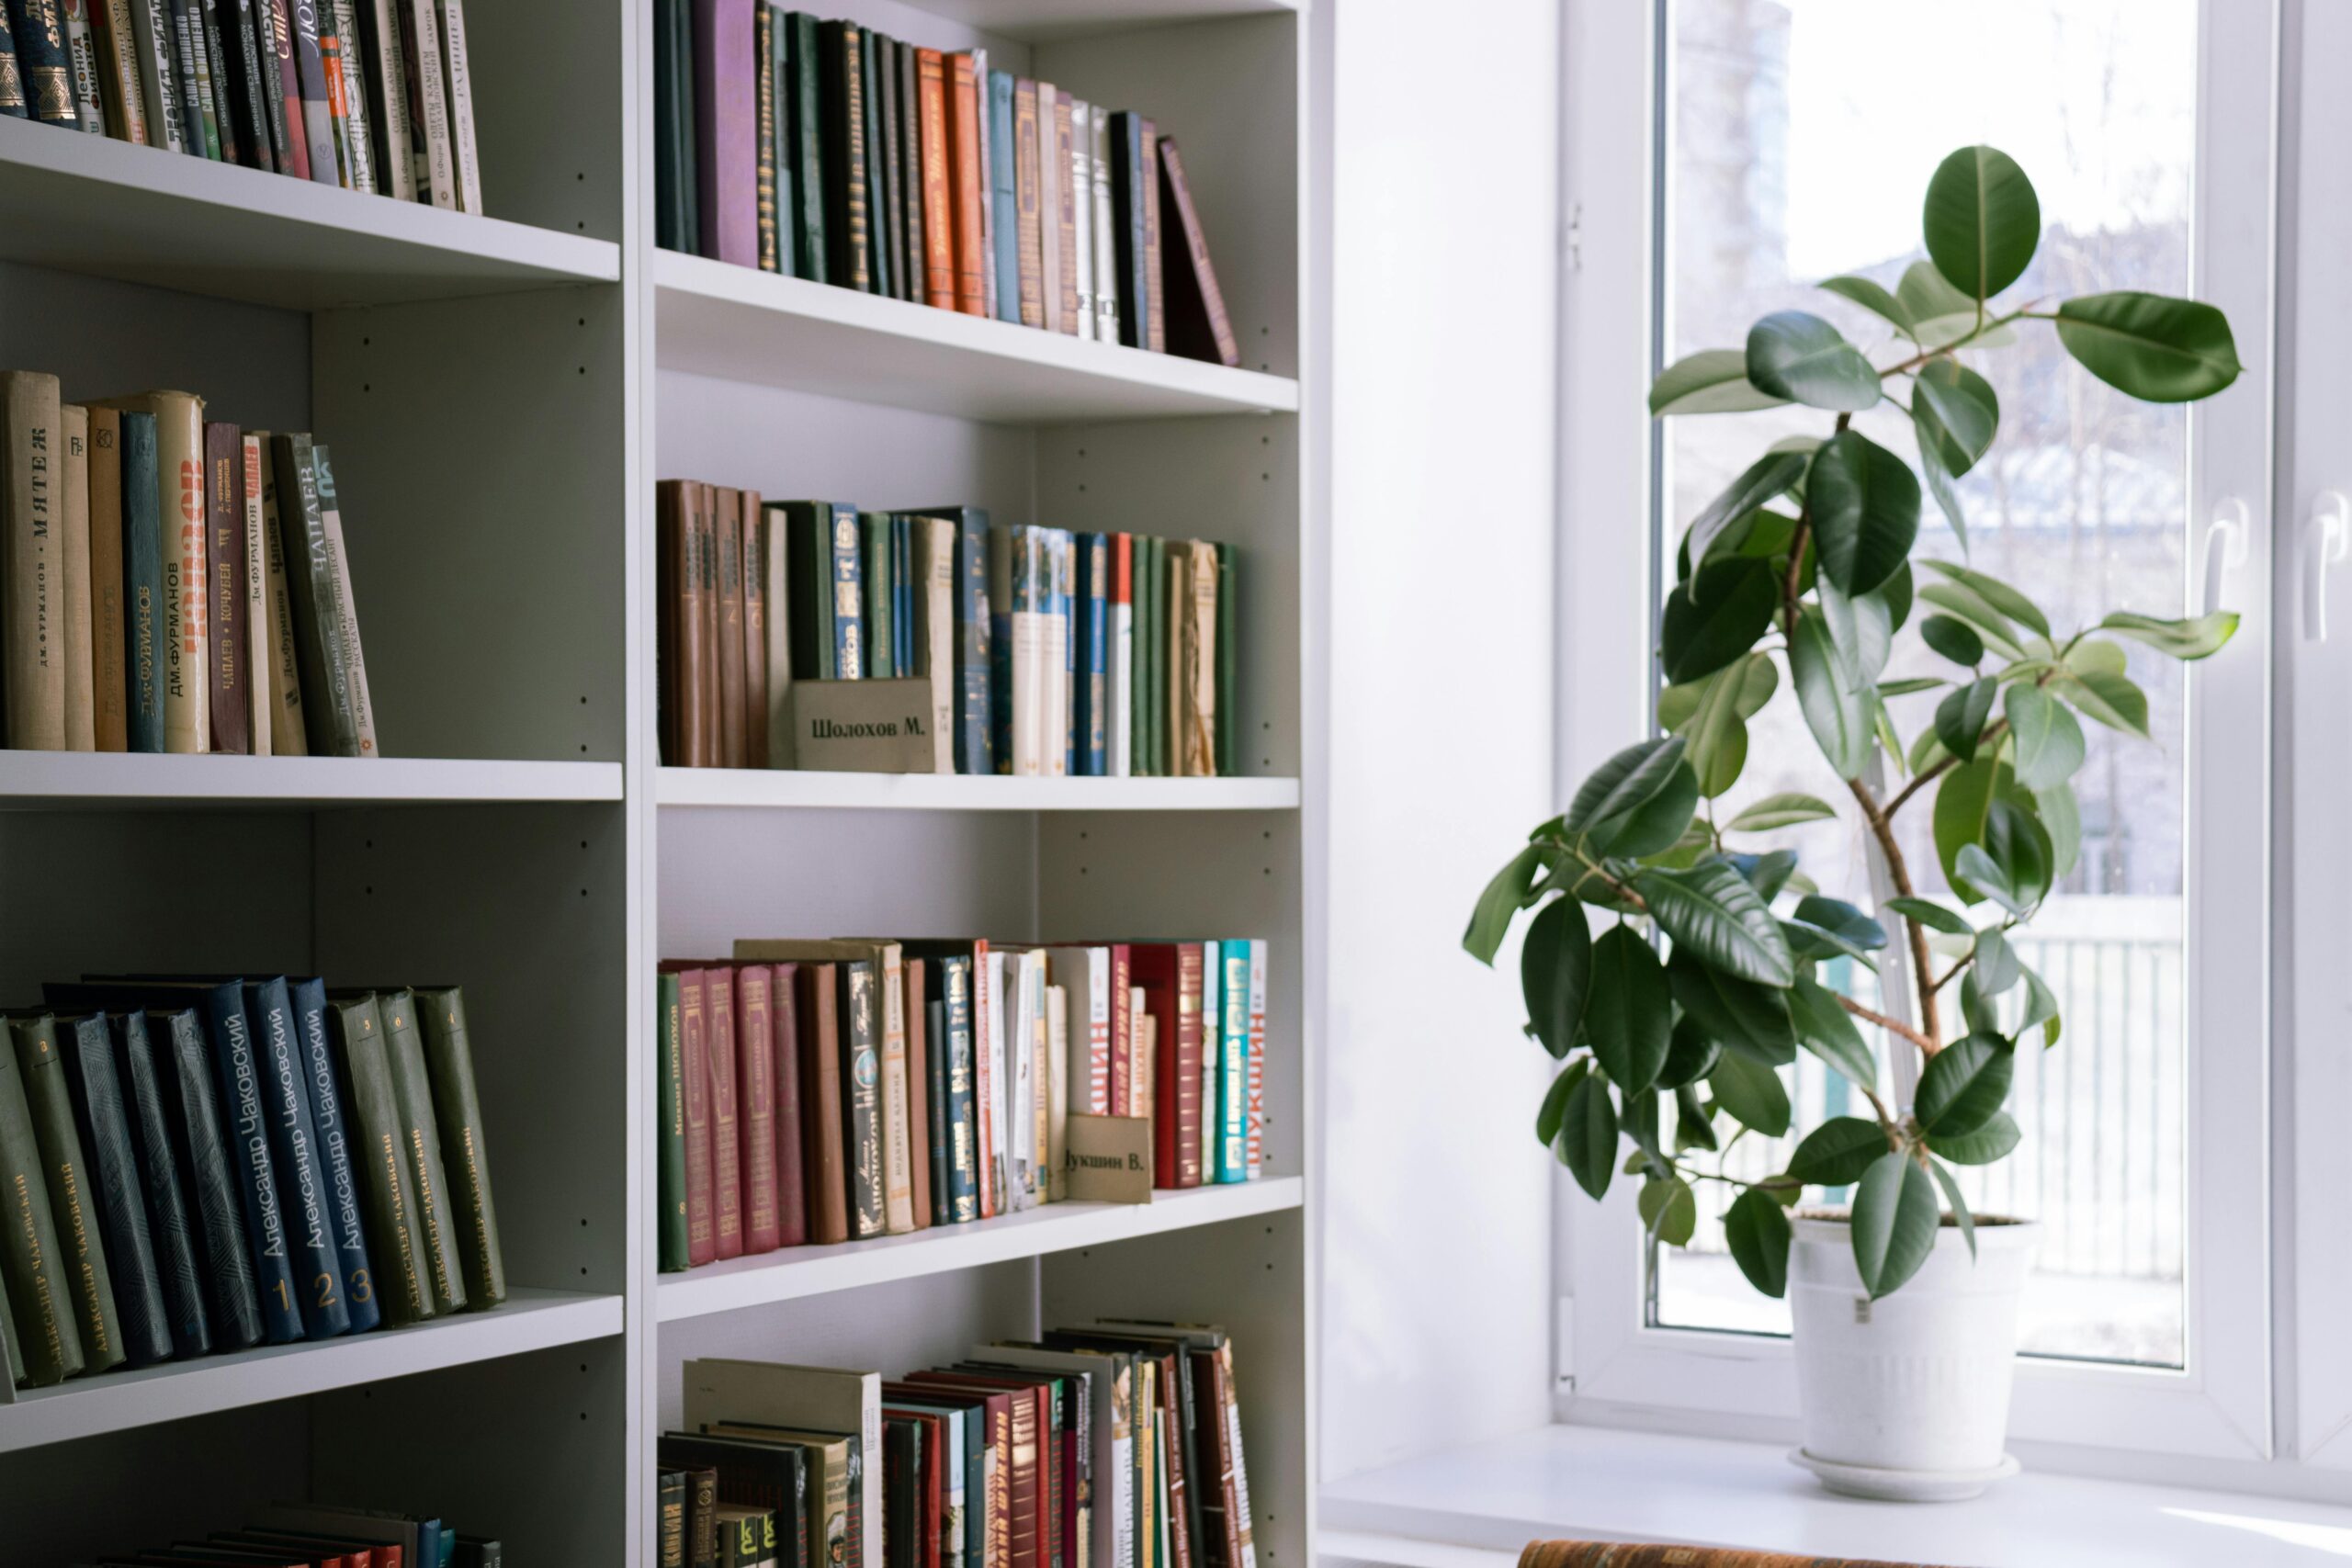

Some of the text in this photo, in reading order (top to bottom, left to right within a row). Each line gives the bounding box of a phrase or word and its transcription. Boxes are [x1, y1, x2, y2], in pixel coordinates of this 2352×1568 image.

[72, 37, 90, 105] Леонид
[83, 32, 100, 109] Филатов
[175, 16, 199, 107] САША ФИЛИПЕНКО
[188, 6, 214, 112] САША ФИЛИПЕНКО
[209, 26, 228, 127] ИЗВЕСТНЫЕ ПОЛИТИКИ
[241, 24, 251, 63] МОНАХИ
[248, 75, 262, 136] СВЯЩЕННИКИ
[249, 44, 260, 84] ЛЮБИЛИ
[385, 47, 401, 133] ОДЕТЫ КАМНЕМ
[388, 5, 409, 133] МИХАЙЛОВСКИЙ ЗАМОК
[423, 51, 437, 139] ОДЕТЫ КАМНЕМ
[424, 7, 446, 139] МИХАЙЛОВСКИЙ ЗАМОК
[160, 69, 181, 141] ЛЕОНИД
[400, 147, 410, 184] О.Форш
[244, 445, 260, 499] ЧАПАЕВ
[31, 427, 48, 667] ДМ. ФУРМАНОВ МЯТЕЖ
[248, 504, 261, 583] ФУРМАНОВ
[266, 516, 284, 574] Чапаев
[300, 467, 327, 572] ЧАПАЕВ
[326, 536, 341, 575] ДЕСАНТ
[218, 562, 234, 690] ЧАПАЕВ КОЧУБЕЙ
[327, 630, 345, 694] Фурманов
[347, 617, 363, 668] РАССКАЗЫ
[811, 716, 926, 739] Шолохов М.
[363, 1020, 372, 1031] 5
[670, 1005, 681, 1078] ШОЛОХОВ
[268, 1008, 325, 1248] Александр Чаковский
[305, 1010, 361, 1250] Александр Чаковский
[674, 1082, 684, 1136] Михаил
[1248, 1012, 1265, 1165] ШУКШИН
[224, 1013, 284, 1258] Александр Чаковский
[1064, 1150, 1145, 1171] укшин В.
[382, 1134, 421, 1308] АЛЕКСАНДР ЧАКОВСКИЙ
[411, 1128, 451, 1300] АЛЕКСАНДР ЧАКОВСКИЙ
[462, 1126, 496, 1298] АЛЕКСАНДР ЧАКОВСКИЙ
[14, 1173, 64, 1366] АЛЕКСАНДР ЧАКОВСКИЙ
[61, 1162, 108, 1352] АЛЕКСАНДР ЧАКОВСКИЙ
[273, 1279, 289, 1311] 1
[314, 1271, 338, 1307] 2
[351, 1268, 372, 1303] 3
[996, 1411, 1007, 1510] ШУКШИН
